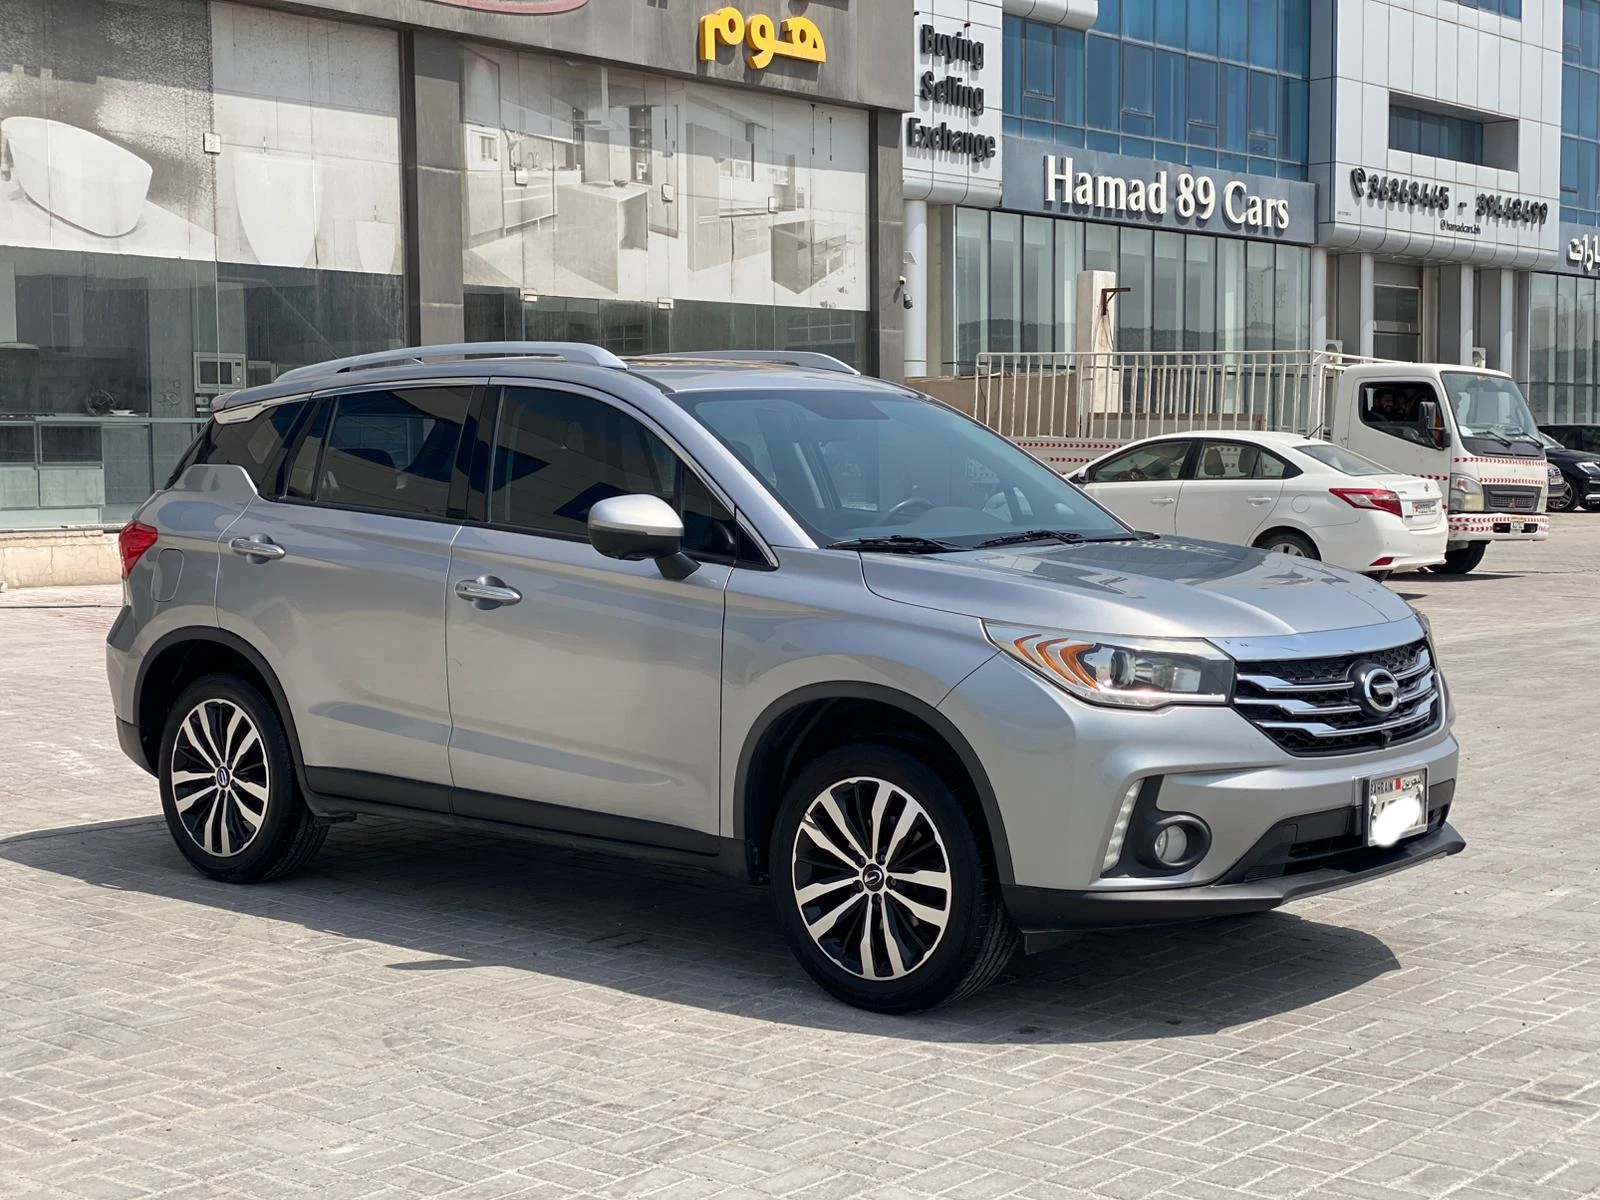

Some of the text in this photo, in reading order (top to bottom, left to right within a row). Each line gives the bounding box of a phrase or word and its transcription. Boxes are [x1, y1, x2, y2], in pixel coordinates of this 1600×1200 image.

[699, 6, 826, 69] هوم
[920, 24, 984, 70] Buying
[920, 71, 984, 116] Selling
[907, 117, 996, 162] Exchange
[1044, 155, 1289, 229] Hamad 89 Cars
[1568, 233, 1600, 271] ارات
